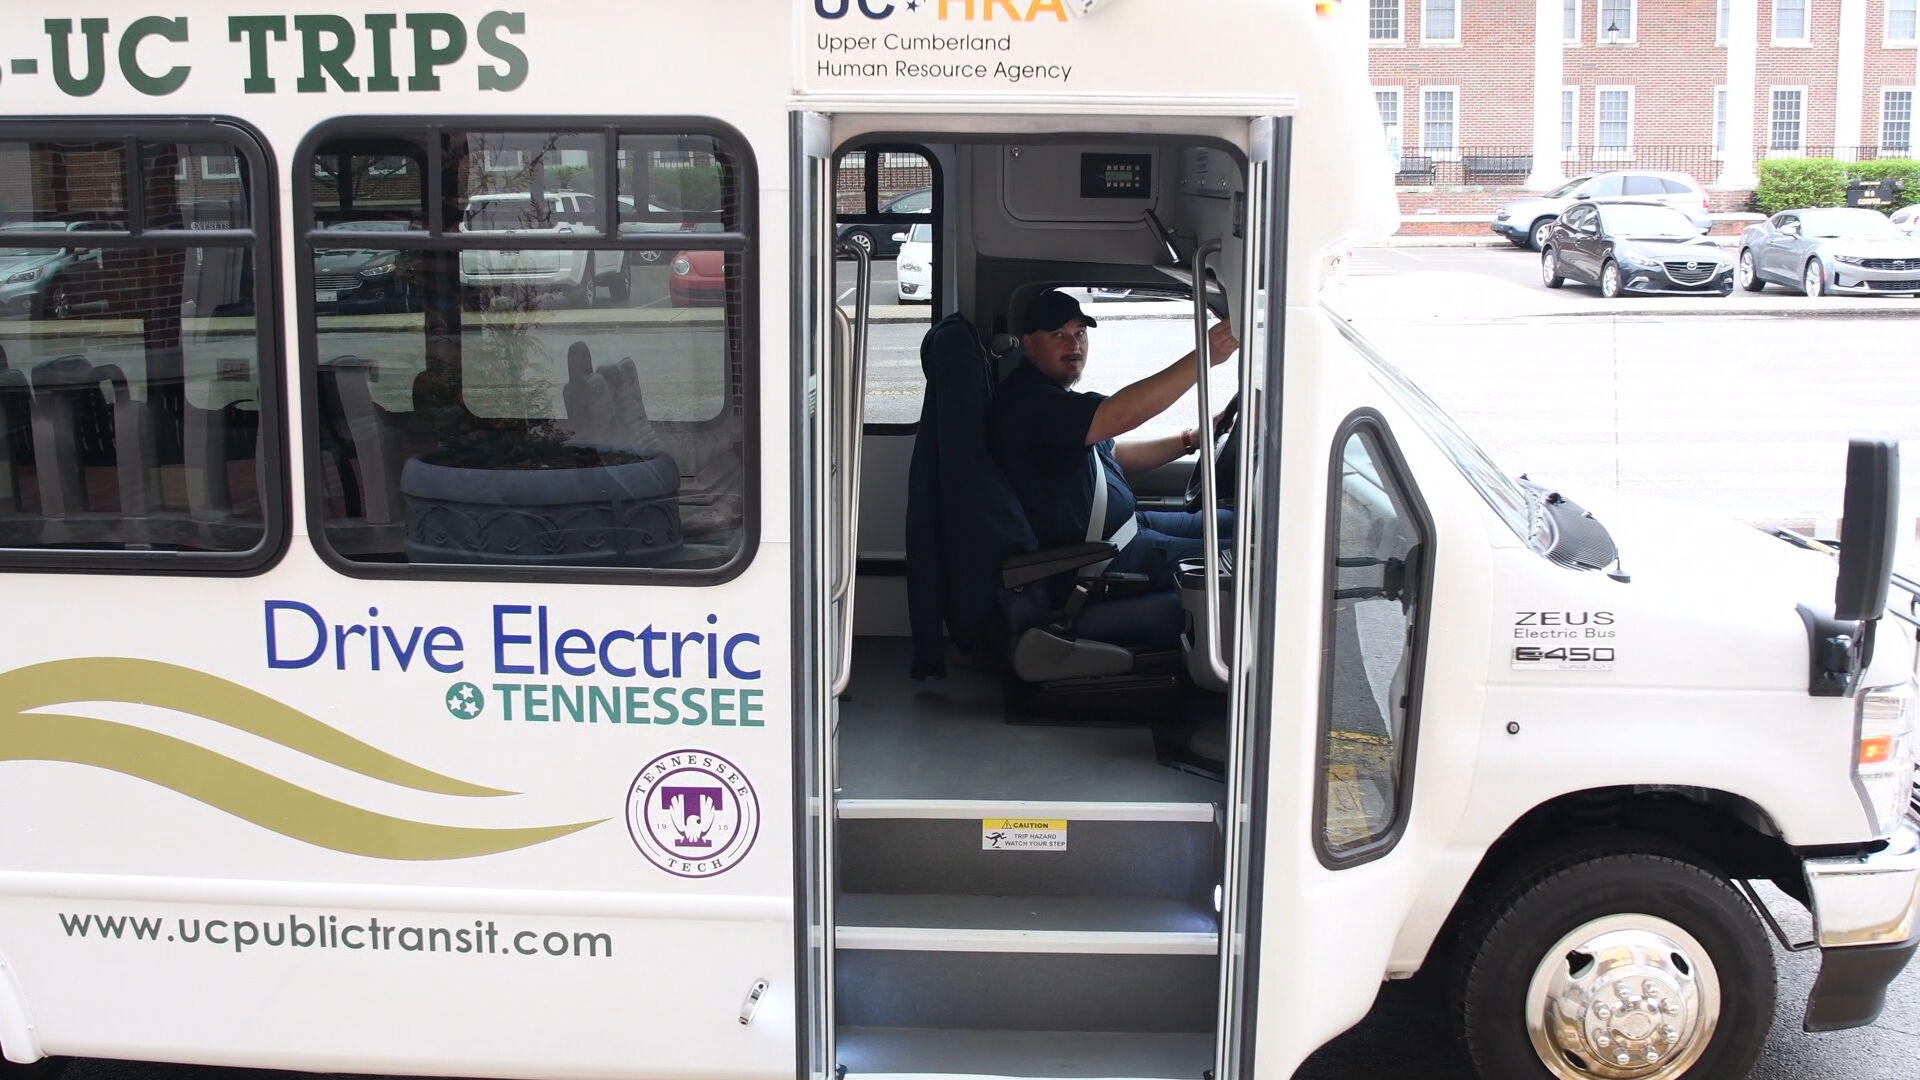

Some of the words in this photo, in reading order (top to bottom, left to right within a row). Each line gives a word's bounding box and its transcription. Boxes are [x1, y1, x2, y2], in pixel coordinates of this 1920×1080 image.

[0, 15, 191, 97] -UC
[228, 10, 528, 95] TRIPS
[817, 33, 876, 53] Upper
[884, 33, 1011, 51] Cumberland
[817, 60, 888, 77] Human
[896, 60, 988, 78] Resource
[994, 61, 1072, 83] Agency
[1514, 611, 1615, 626] ZEUS
[265, 600, 464, 673] Drive
[493, 604, 761, 680] Electric
[1514, 627, 1577, 639] Electric
[1585, 627, 1616, 639] Bus
[1515, 646, 1615, 662] E-450
[493, 684, 764, 727] TENNESSEE
[635, 755, 749, 797] TENNESSEE
[668, 858, 723, 872] TECH
[59, 911, 612, 958] www.ucpublictransit.com
